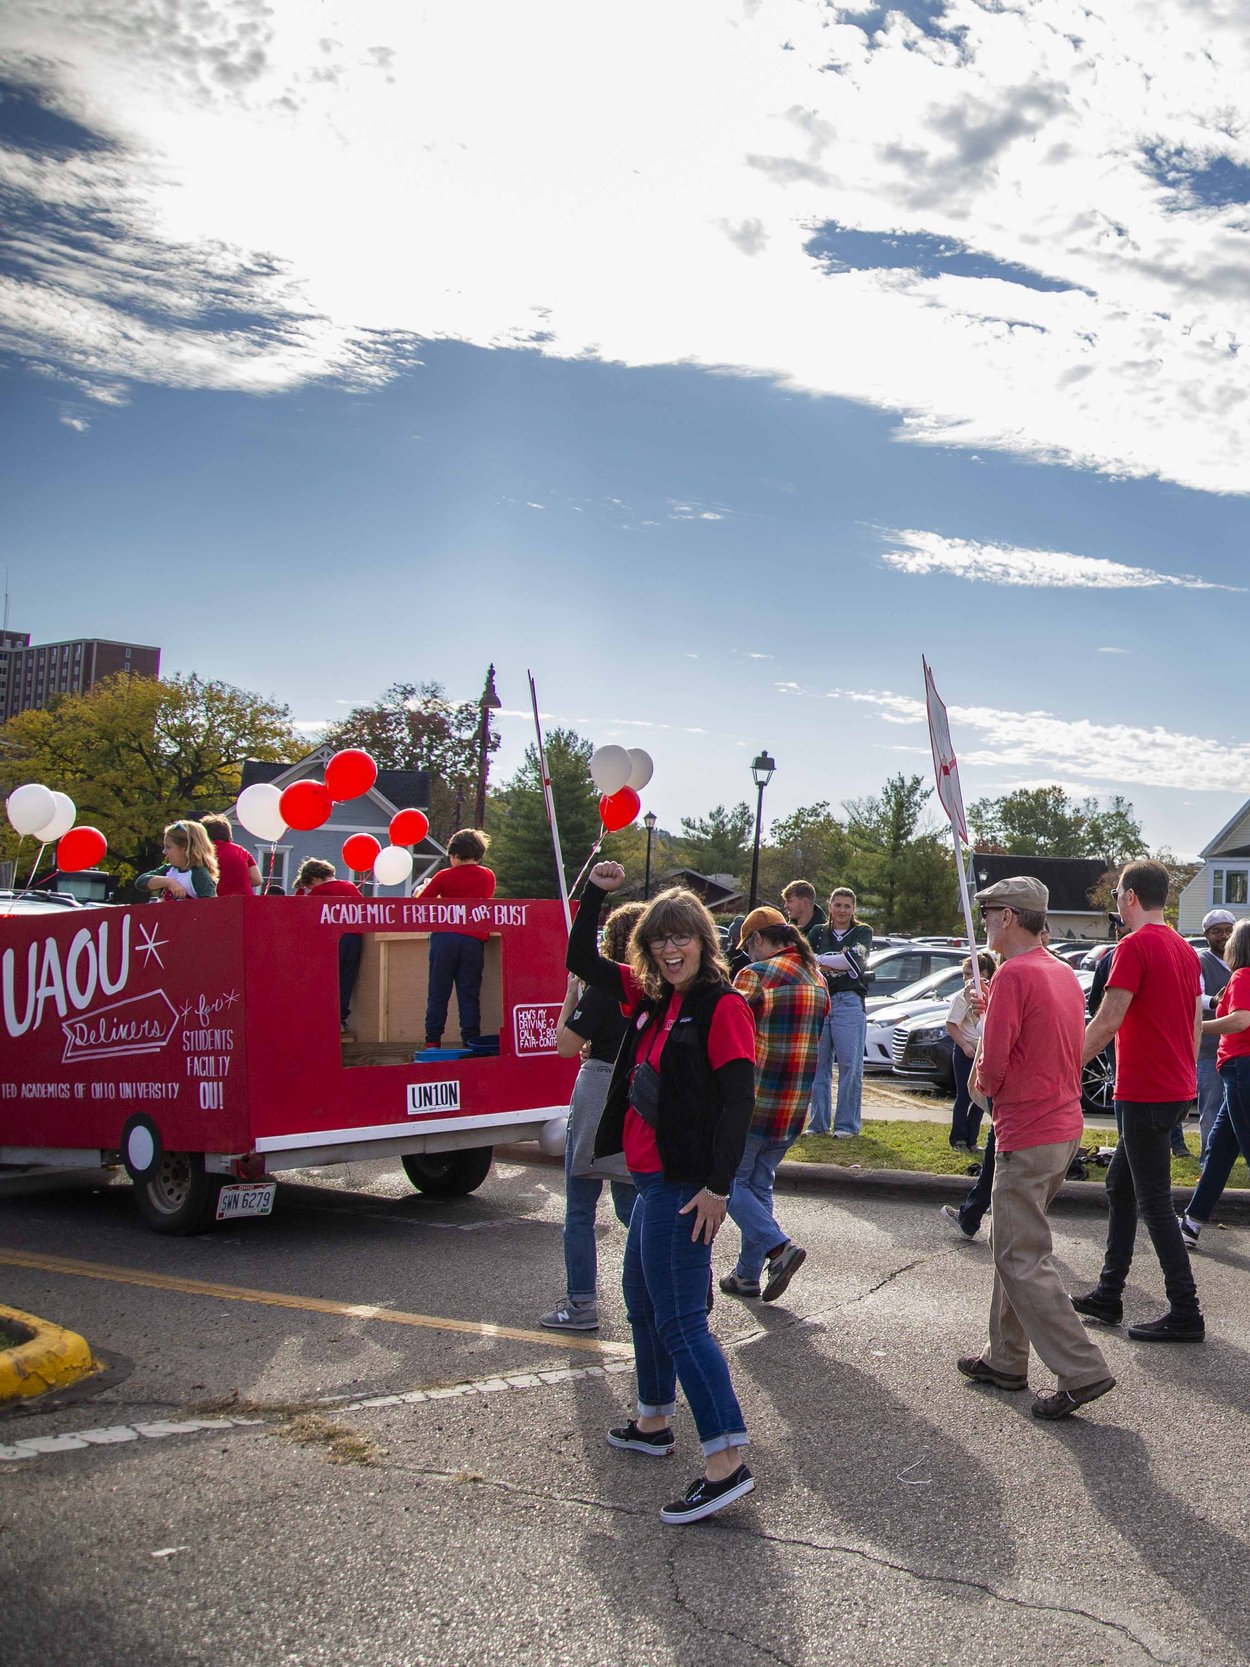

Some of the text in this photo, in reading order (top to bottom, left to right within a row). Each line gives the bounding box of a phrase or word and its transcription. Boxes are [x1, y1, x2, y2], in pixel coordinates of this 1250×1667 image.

[320, 903, 396, 925] ACADEMIC
[402, 904, 467, 925] FREEDOM
[494, 904, 531, 926] BUST
[194, 993, 224, 1028] for
[74, 1017, 168, 1046] Delivers
[182, 1029, 234, 1052] STUDENTS
[187, 1056, 231, 1078] FACULTY
[21, 1083, 71, 1099] ACADEMICS
[74, 1083, 87, 1099] OF
[91, 1082, 116, 1099] OHIO
[119, 1082, 180, 1099] UNIVERSITY
[199, 1081, 225, 1110] OU!
[241, 1191, 271, 1209] 6279
